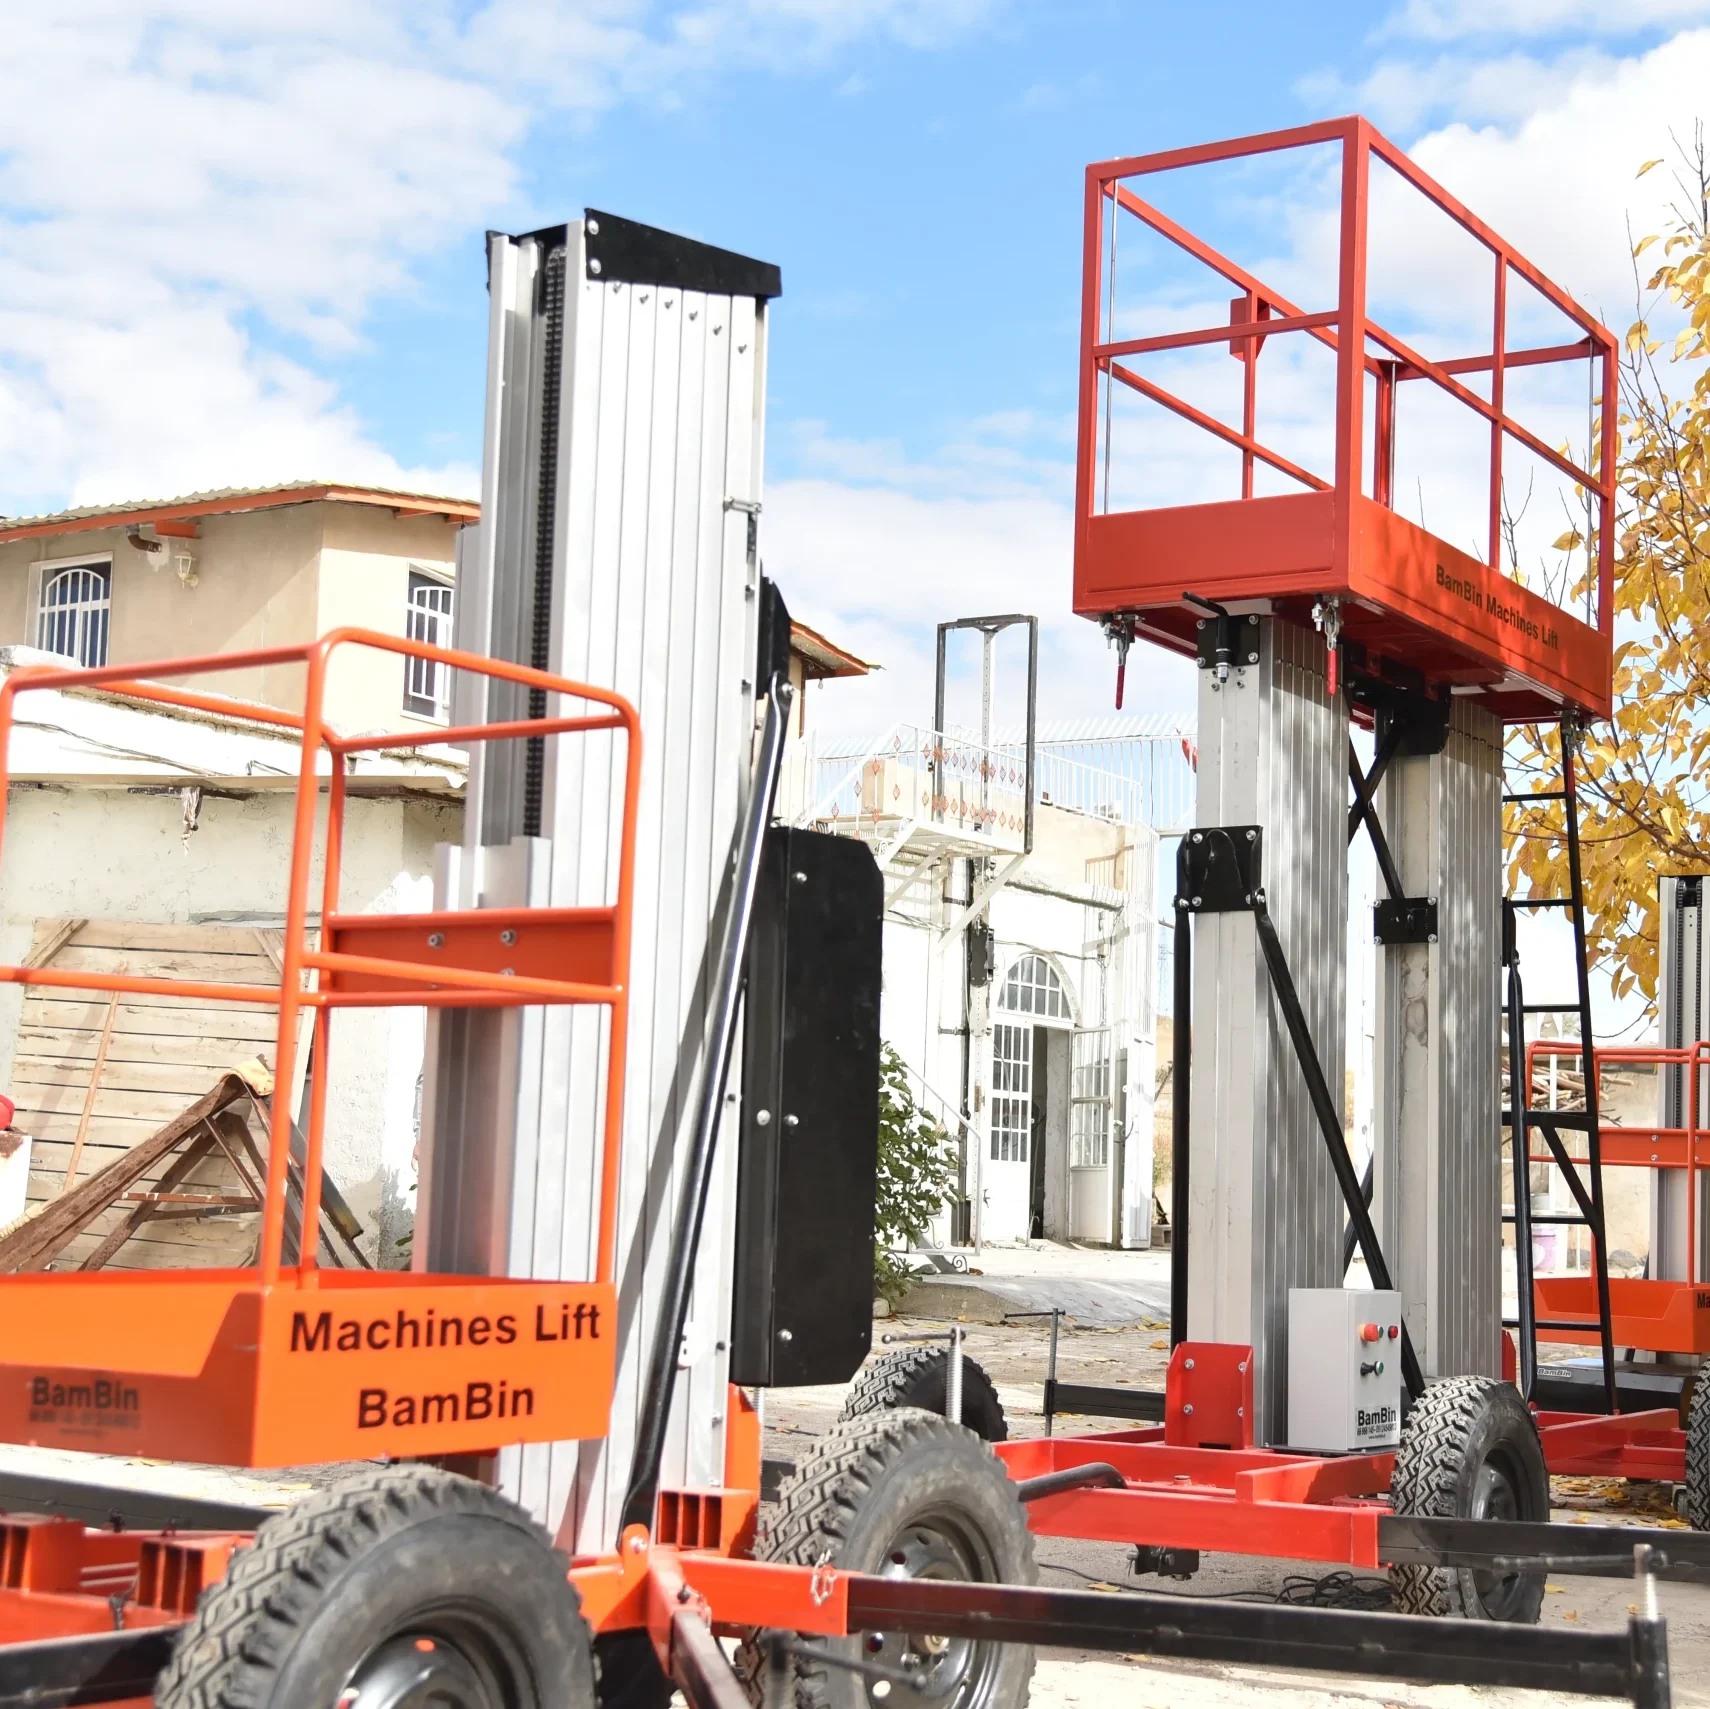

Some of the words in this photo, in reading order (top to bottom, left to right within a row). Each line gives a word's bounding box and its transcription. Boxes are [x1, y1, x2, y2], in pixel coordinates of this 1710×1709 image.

[1436, 563, 1483, 610] BamBin
[1486, 593, 1539, 641] Machines
[1541, 624, 1559, 650] Lift
[289, 1307, 518, 1353] Machines
[534, 1302, 600, 1342] Lift
[32, 1376, 139, 1411] BamBin
[1537, 1368, 1572, 1378] BamBin
[357, 1380, 535, 1429] BamBin
[1357, 1406, 1397, 1427] BamBin
